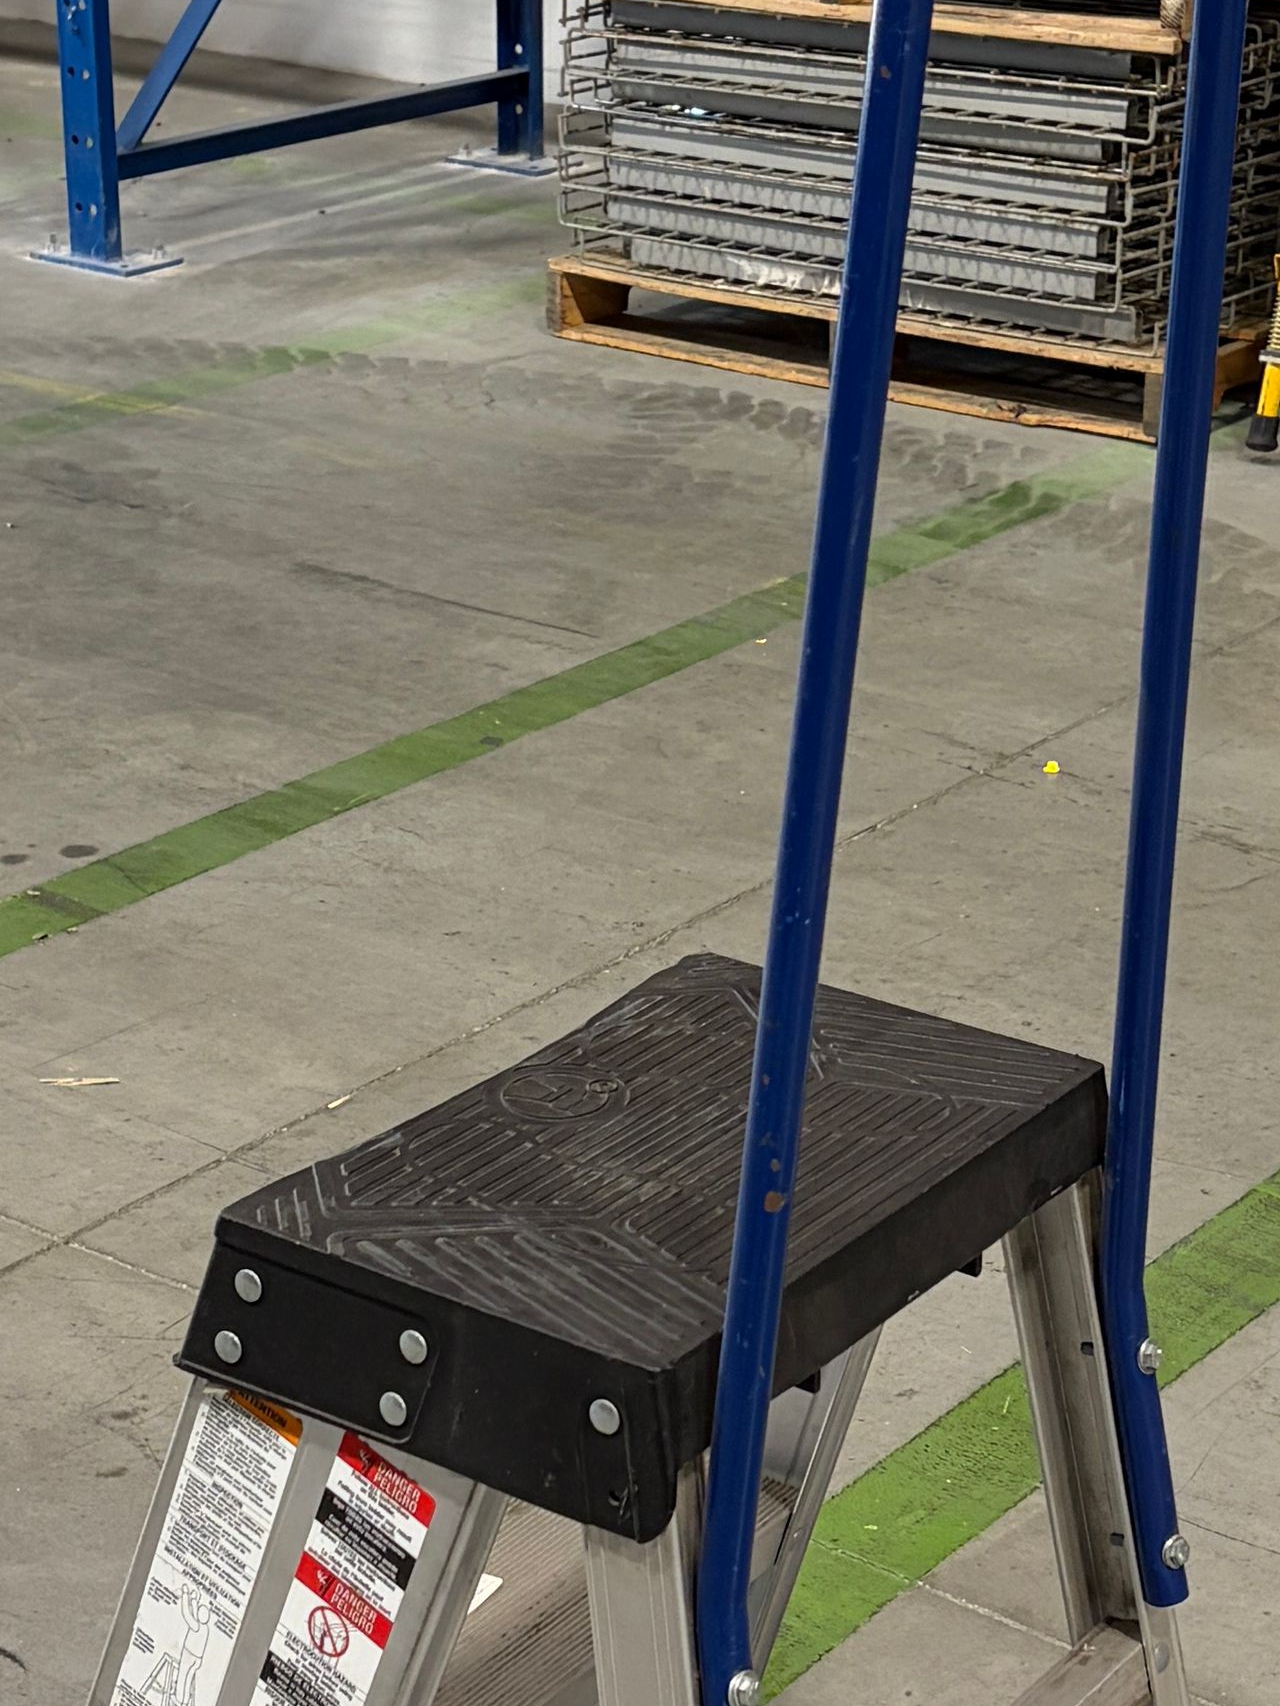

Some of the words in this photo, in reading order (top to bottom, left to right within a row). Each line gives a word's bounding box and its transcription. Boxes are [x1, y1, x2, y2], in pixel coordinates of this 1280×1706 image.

[372, 1469, 418, 1516] PELIGRO
[377, 1458, 422, 1504] DANGER
[329, 1591, 374, 1636] PELIGRO
[333, 1580, 377, 1624] DANGER
